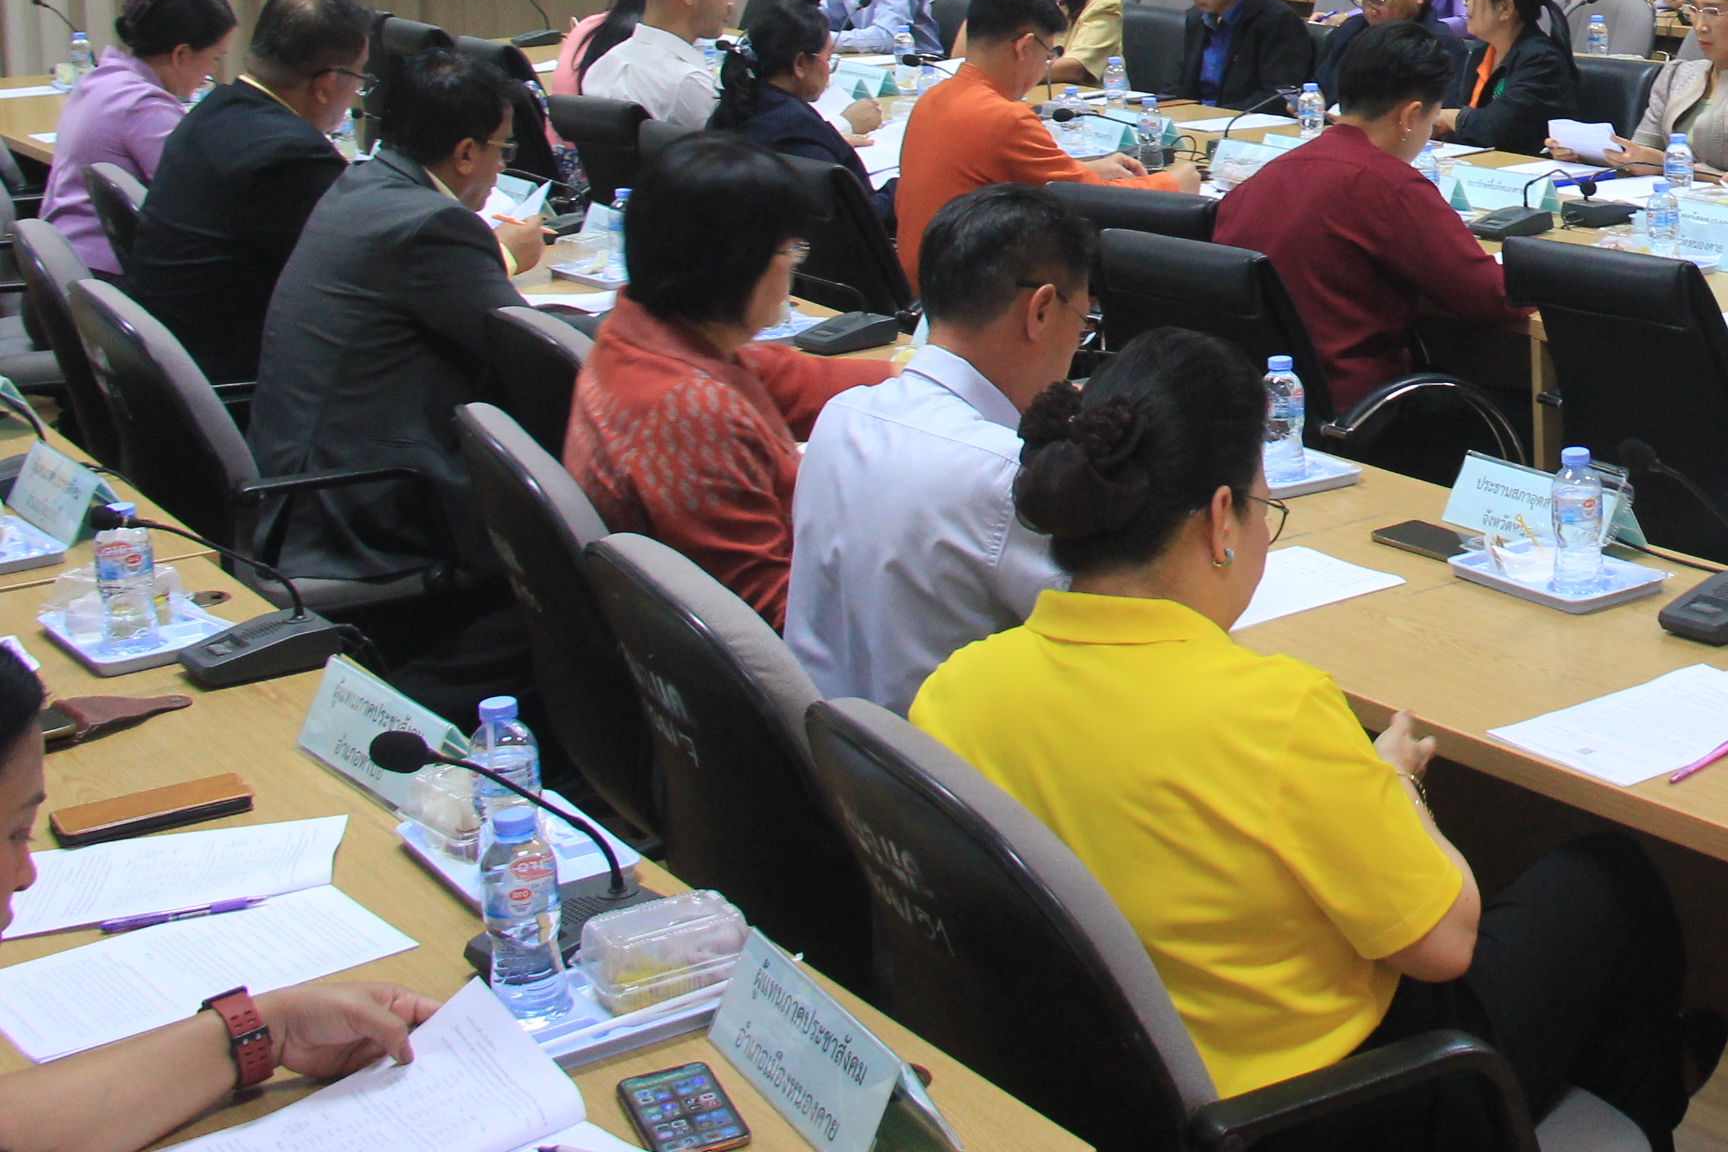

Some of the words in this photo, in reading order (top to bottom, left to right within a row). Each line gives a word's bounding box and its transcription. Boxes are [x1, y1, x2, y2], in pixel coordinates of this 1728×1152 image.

[1476, 476, 1551, 511] ประธานสภาอุตส
[734, 1020, 841, 1142] อำเภอเมืองหนองคาย
[752, 958, 868, 1087] ผู้แทนภาคประชาสังคม
